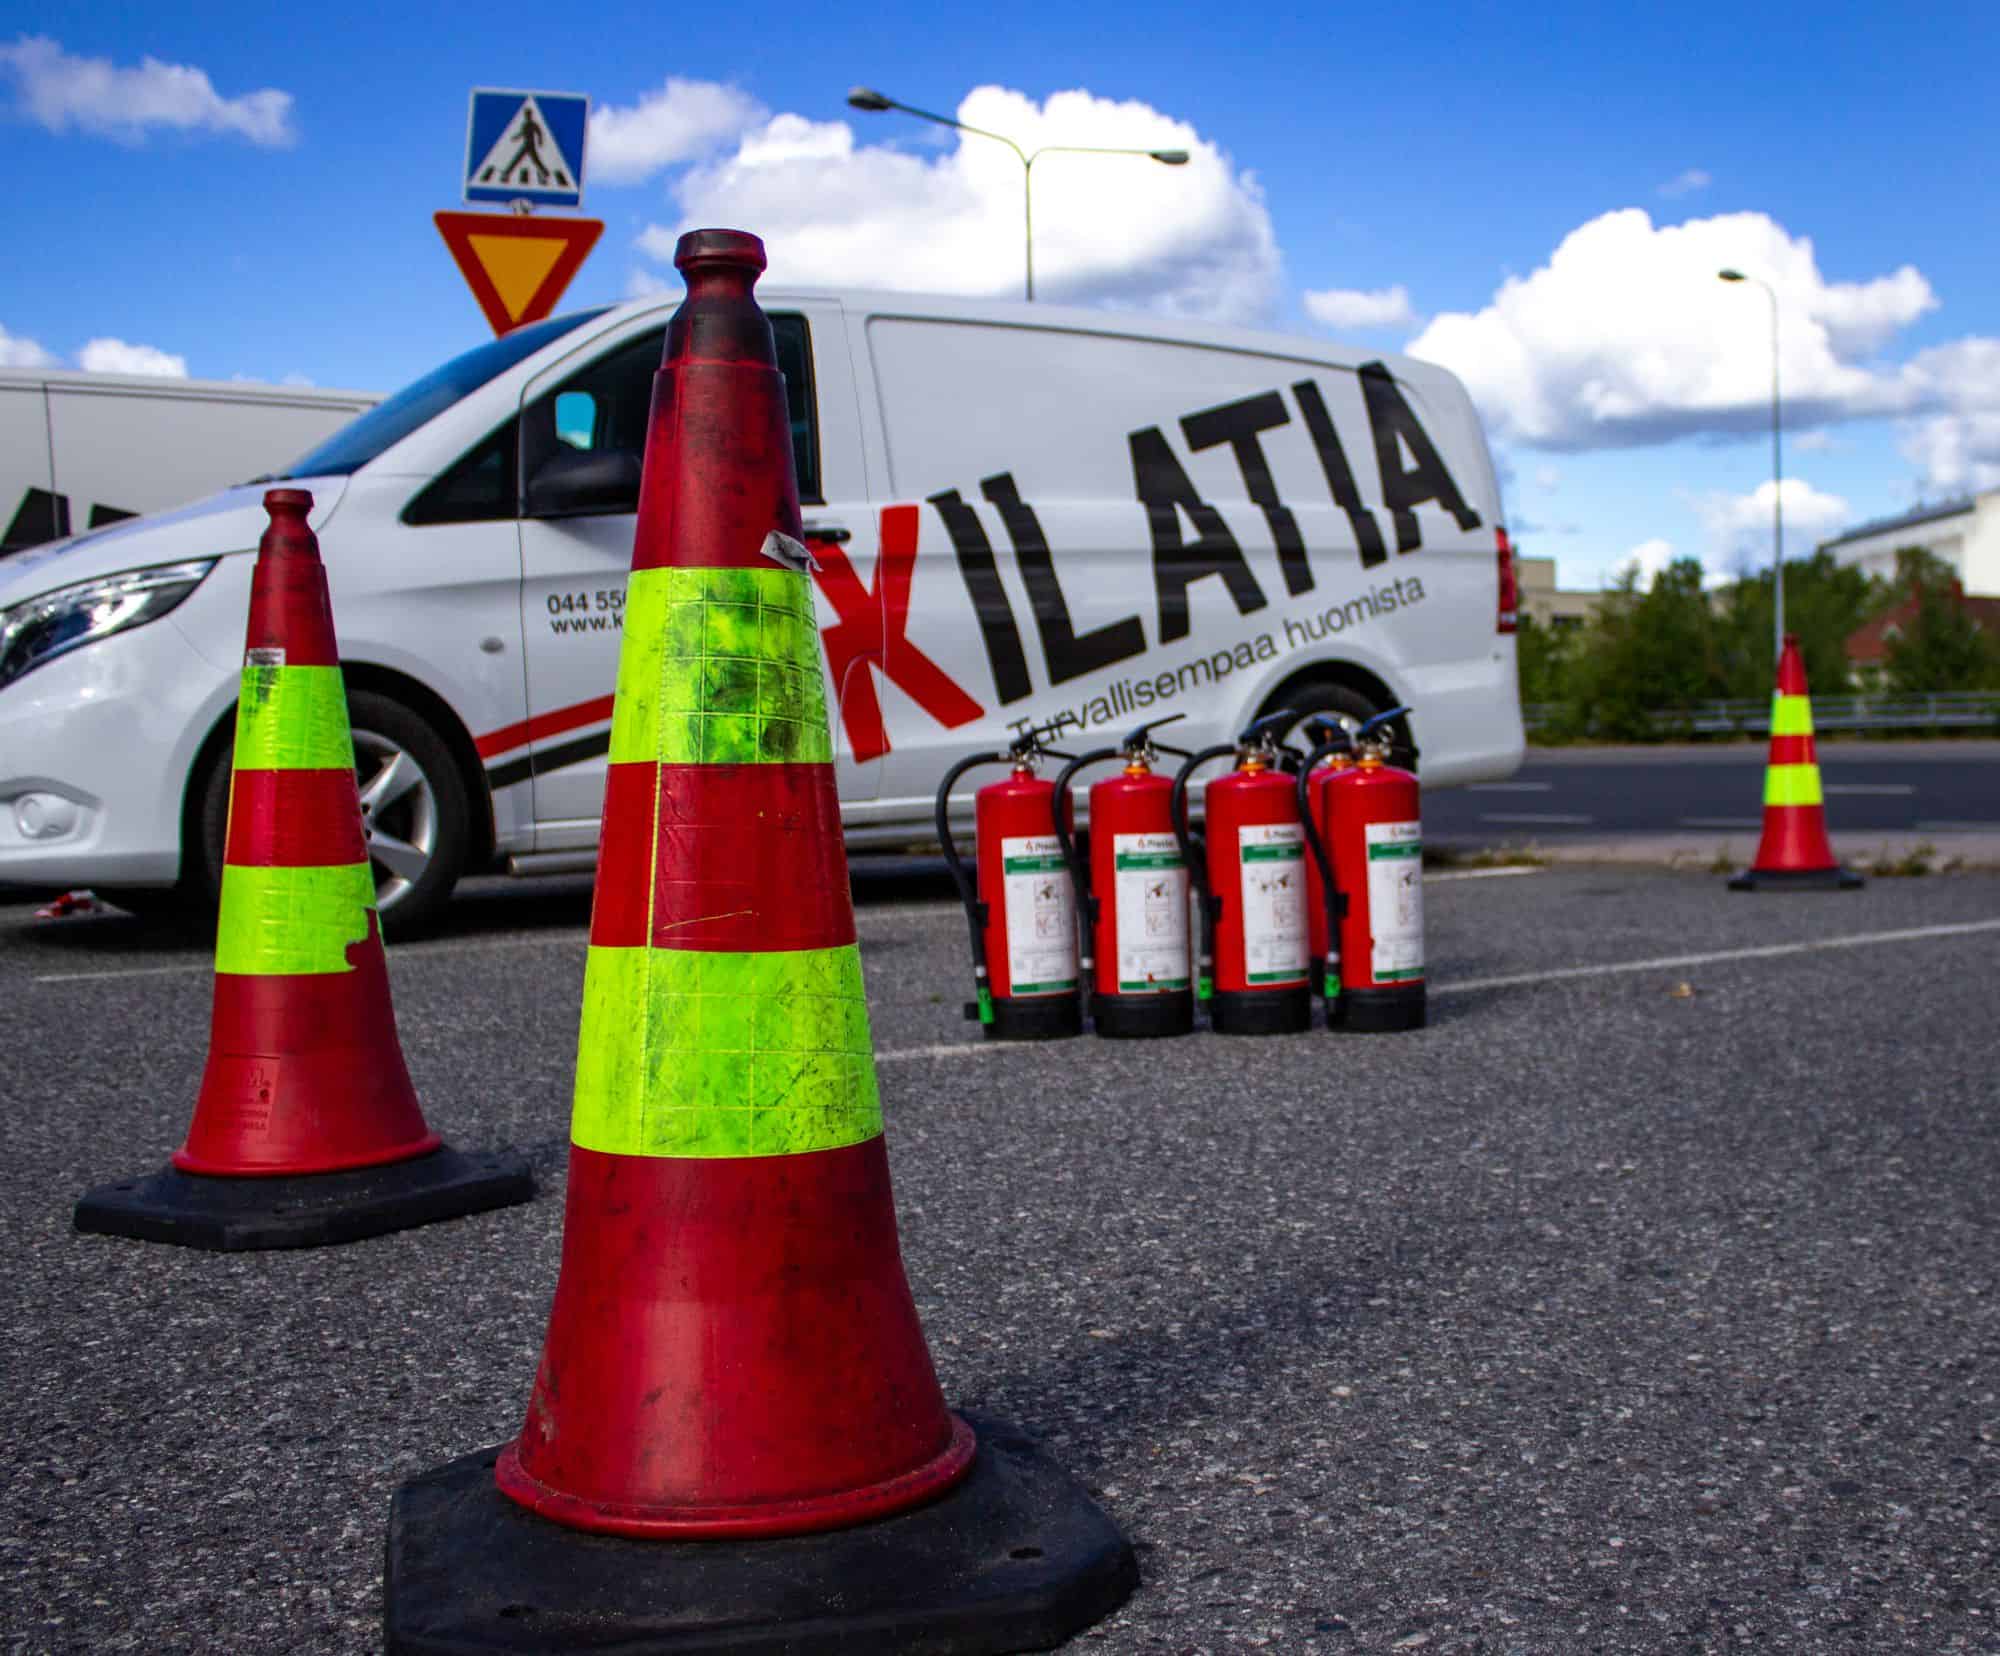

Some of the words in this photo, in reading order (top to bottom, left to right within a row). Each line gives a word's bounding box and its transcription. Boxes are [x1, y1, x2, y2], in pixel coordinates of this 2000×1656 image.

[547, 593, 588, 615] 044
[806, 361, 1482, 763] KILATIA
[1006, 633, 1278, 747] Turvallisempaa
[1283, 576, 1425, 649] huomista
